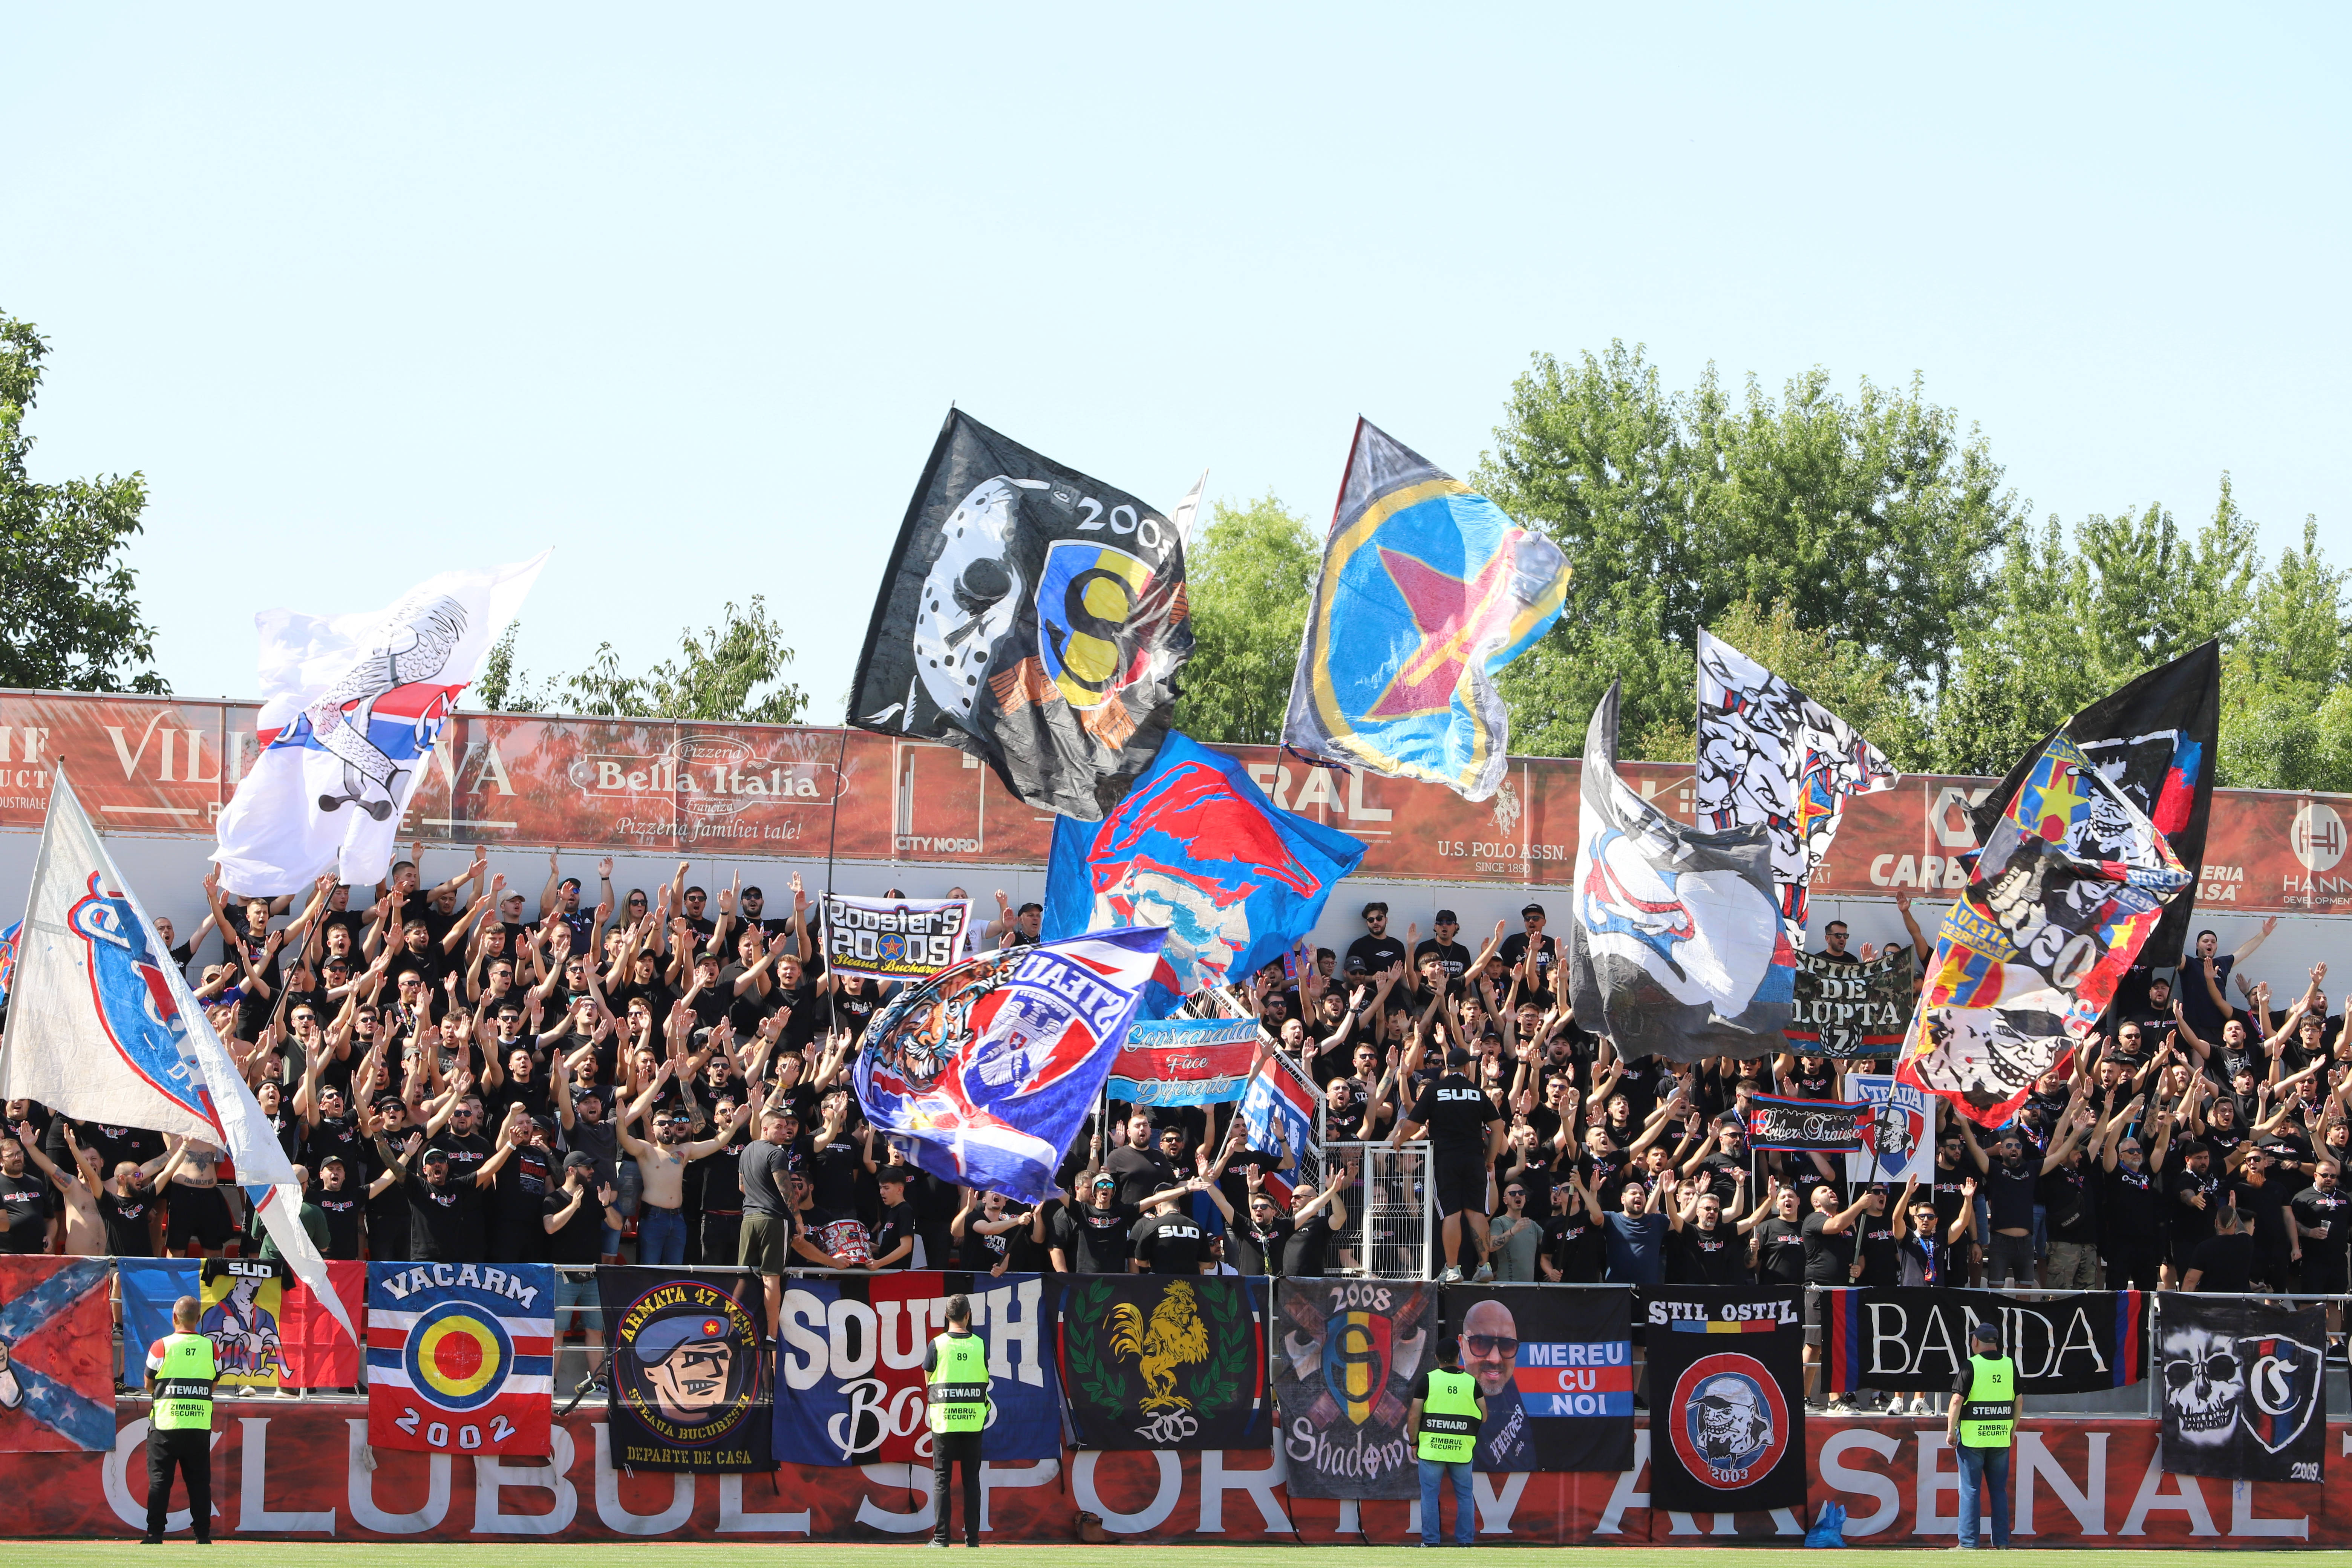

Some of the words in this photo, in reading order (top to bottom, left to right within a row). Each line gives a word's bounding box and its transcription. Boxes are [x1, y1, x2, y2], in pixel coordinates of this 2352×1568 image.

[681, 744, 741, 760] Pizzeria
[597, 761, 700, 792] Bella
[714, 766, 820, 797] Italia
[1248, 764, 1392, 821] RAL
[685, 799, 734, 813] Franciza
[616, 817, 688, 838] Pizzeria
[689, 818, 760, 842] familiei
[764, 820, 801, 840] tale!
[895, 836, 932, 851] CITY
[934, 837, 978, 853] NORD
[1438, 841, 1468, 856] U.S.
[1472, 841, 1516, 859] POLO
[1520, 844, 1567, 861] ASSN.
[1475, 862, 1505, 872] SINCE
[1507, 863, 1530, 874] 1890
[2200, 865, 2243, 881] ERIA
[833, 952, 879, 969] Steaua
[1793, 949, 1894, 980] SPIRIT
[1820, 978, 1867, 999] DE
[1793, 998, 1901, 1026] LUPTA
[1833, 1029, 1849, 1050] 7
[1165, 1054, 1208, 1074] Face
[1436, 1089, 1481, 1101] SUD
[1858, 1083, 1924, 1110] STEAUA
[1158, 1225, 1199, 1239] SUD
[228, 1262, 272, 1278] SUD
[382, 1263, 539, 1309] VACARM
[1329, 1286, 1392, 1314] 2008
[621, 1286, 687, 1343] ARMATA
[694, 1288, 718, 1307] 47
[1648, 1300, 1709, 1325] STIL
[1721, 1300, 1798, 1325] OSTIL
[1865, 1303, 2109, 1378] BANDA
[185, 1348, 196, 1357] 87
[956, 1353, 968, 1361] 89
[1529, 1343, 1623, 1366] MEREU
[1558, 1369, 1596, 1391] CU
[1992, 1374, 2002, 1383] 52
[165, 1385, 209, 1396] STEWARD
[937, 1388, 981, 1398] STEWARD
[1447, 1386, 1458, 1394] 68
[1552, 1394, 1607, 1416] NOI
[1972, 1406, 2011, 1415] STEWARD
[395, 1407, 516, 1449] 2002
[828, 1380, 998, 1461] Bo
[1426, 1419, 1468, 1430] STEWARD
[1430, 1437, 1463, 1446] ZIMBRUL
[1430, 1443, 1462, 1451] SECURITY
[627, 1446, 689, 1464] DEPARTE
[694, 1450, 711, 1464] DE
[716, 1450, 752, 1464] CASA
[1591, 1425, 2309, 1541] ASENAL
[1711, 1468, 1748, 1482] 2003
